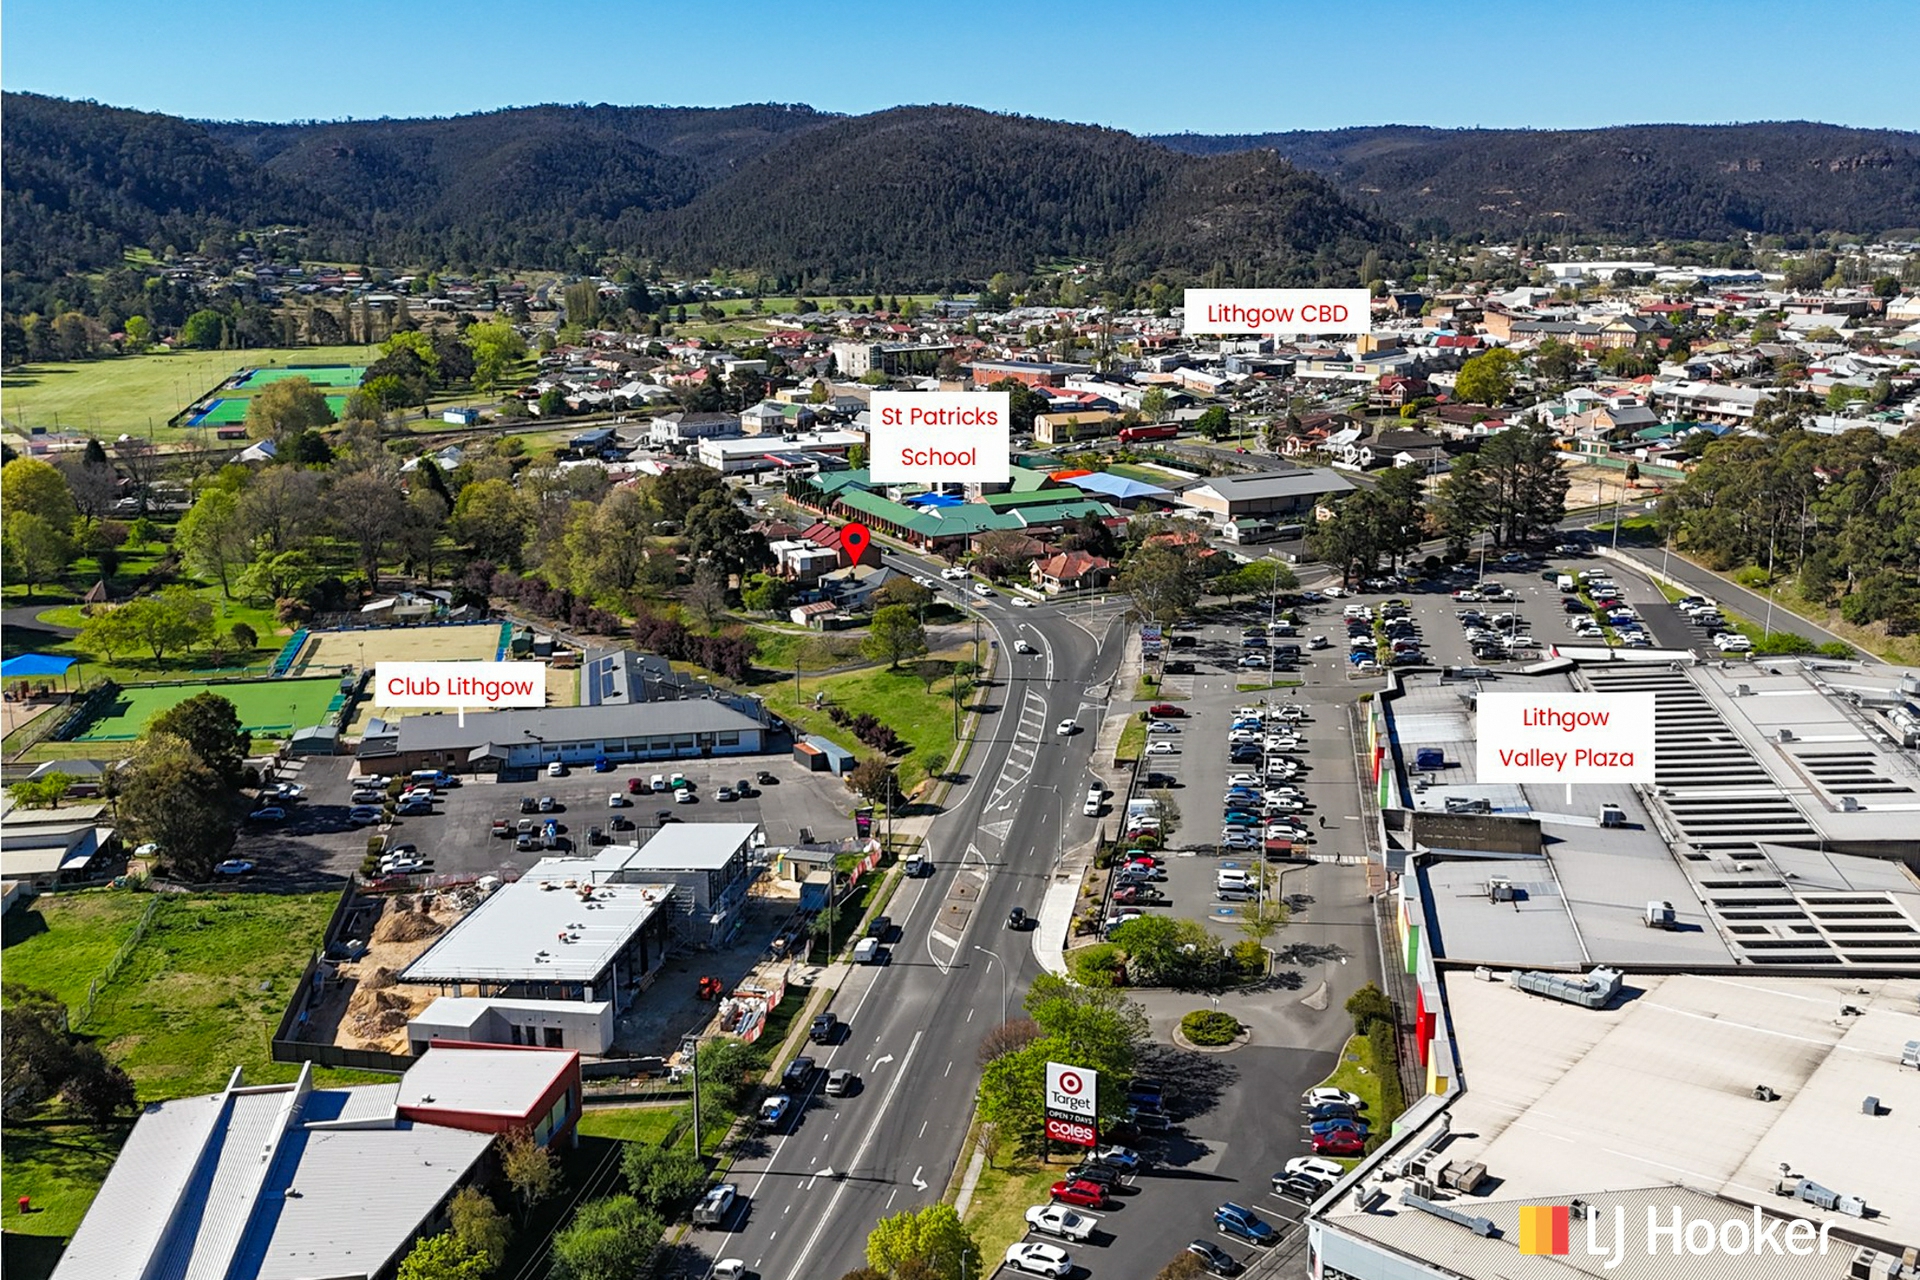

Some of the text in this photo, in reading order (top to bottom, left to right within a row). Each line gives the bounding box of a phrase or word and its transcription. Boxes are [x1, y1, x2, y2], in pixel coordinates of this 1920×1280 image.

[1051, 1091, 1091, 1110] Target
[1048, 1110, 1069, 1119] OPEN
[1075, 1115, 1093, 1124] DAYS
